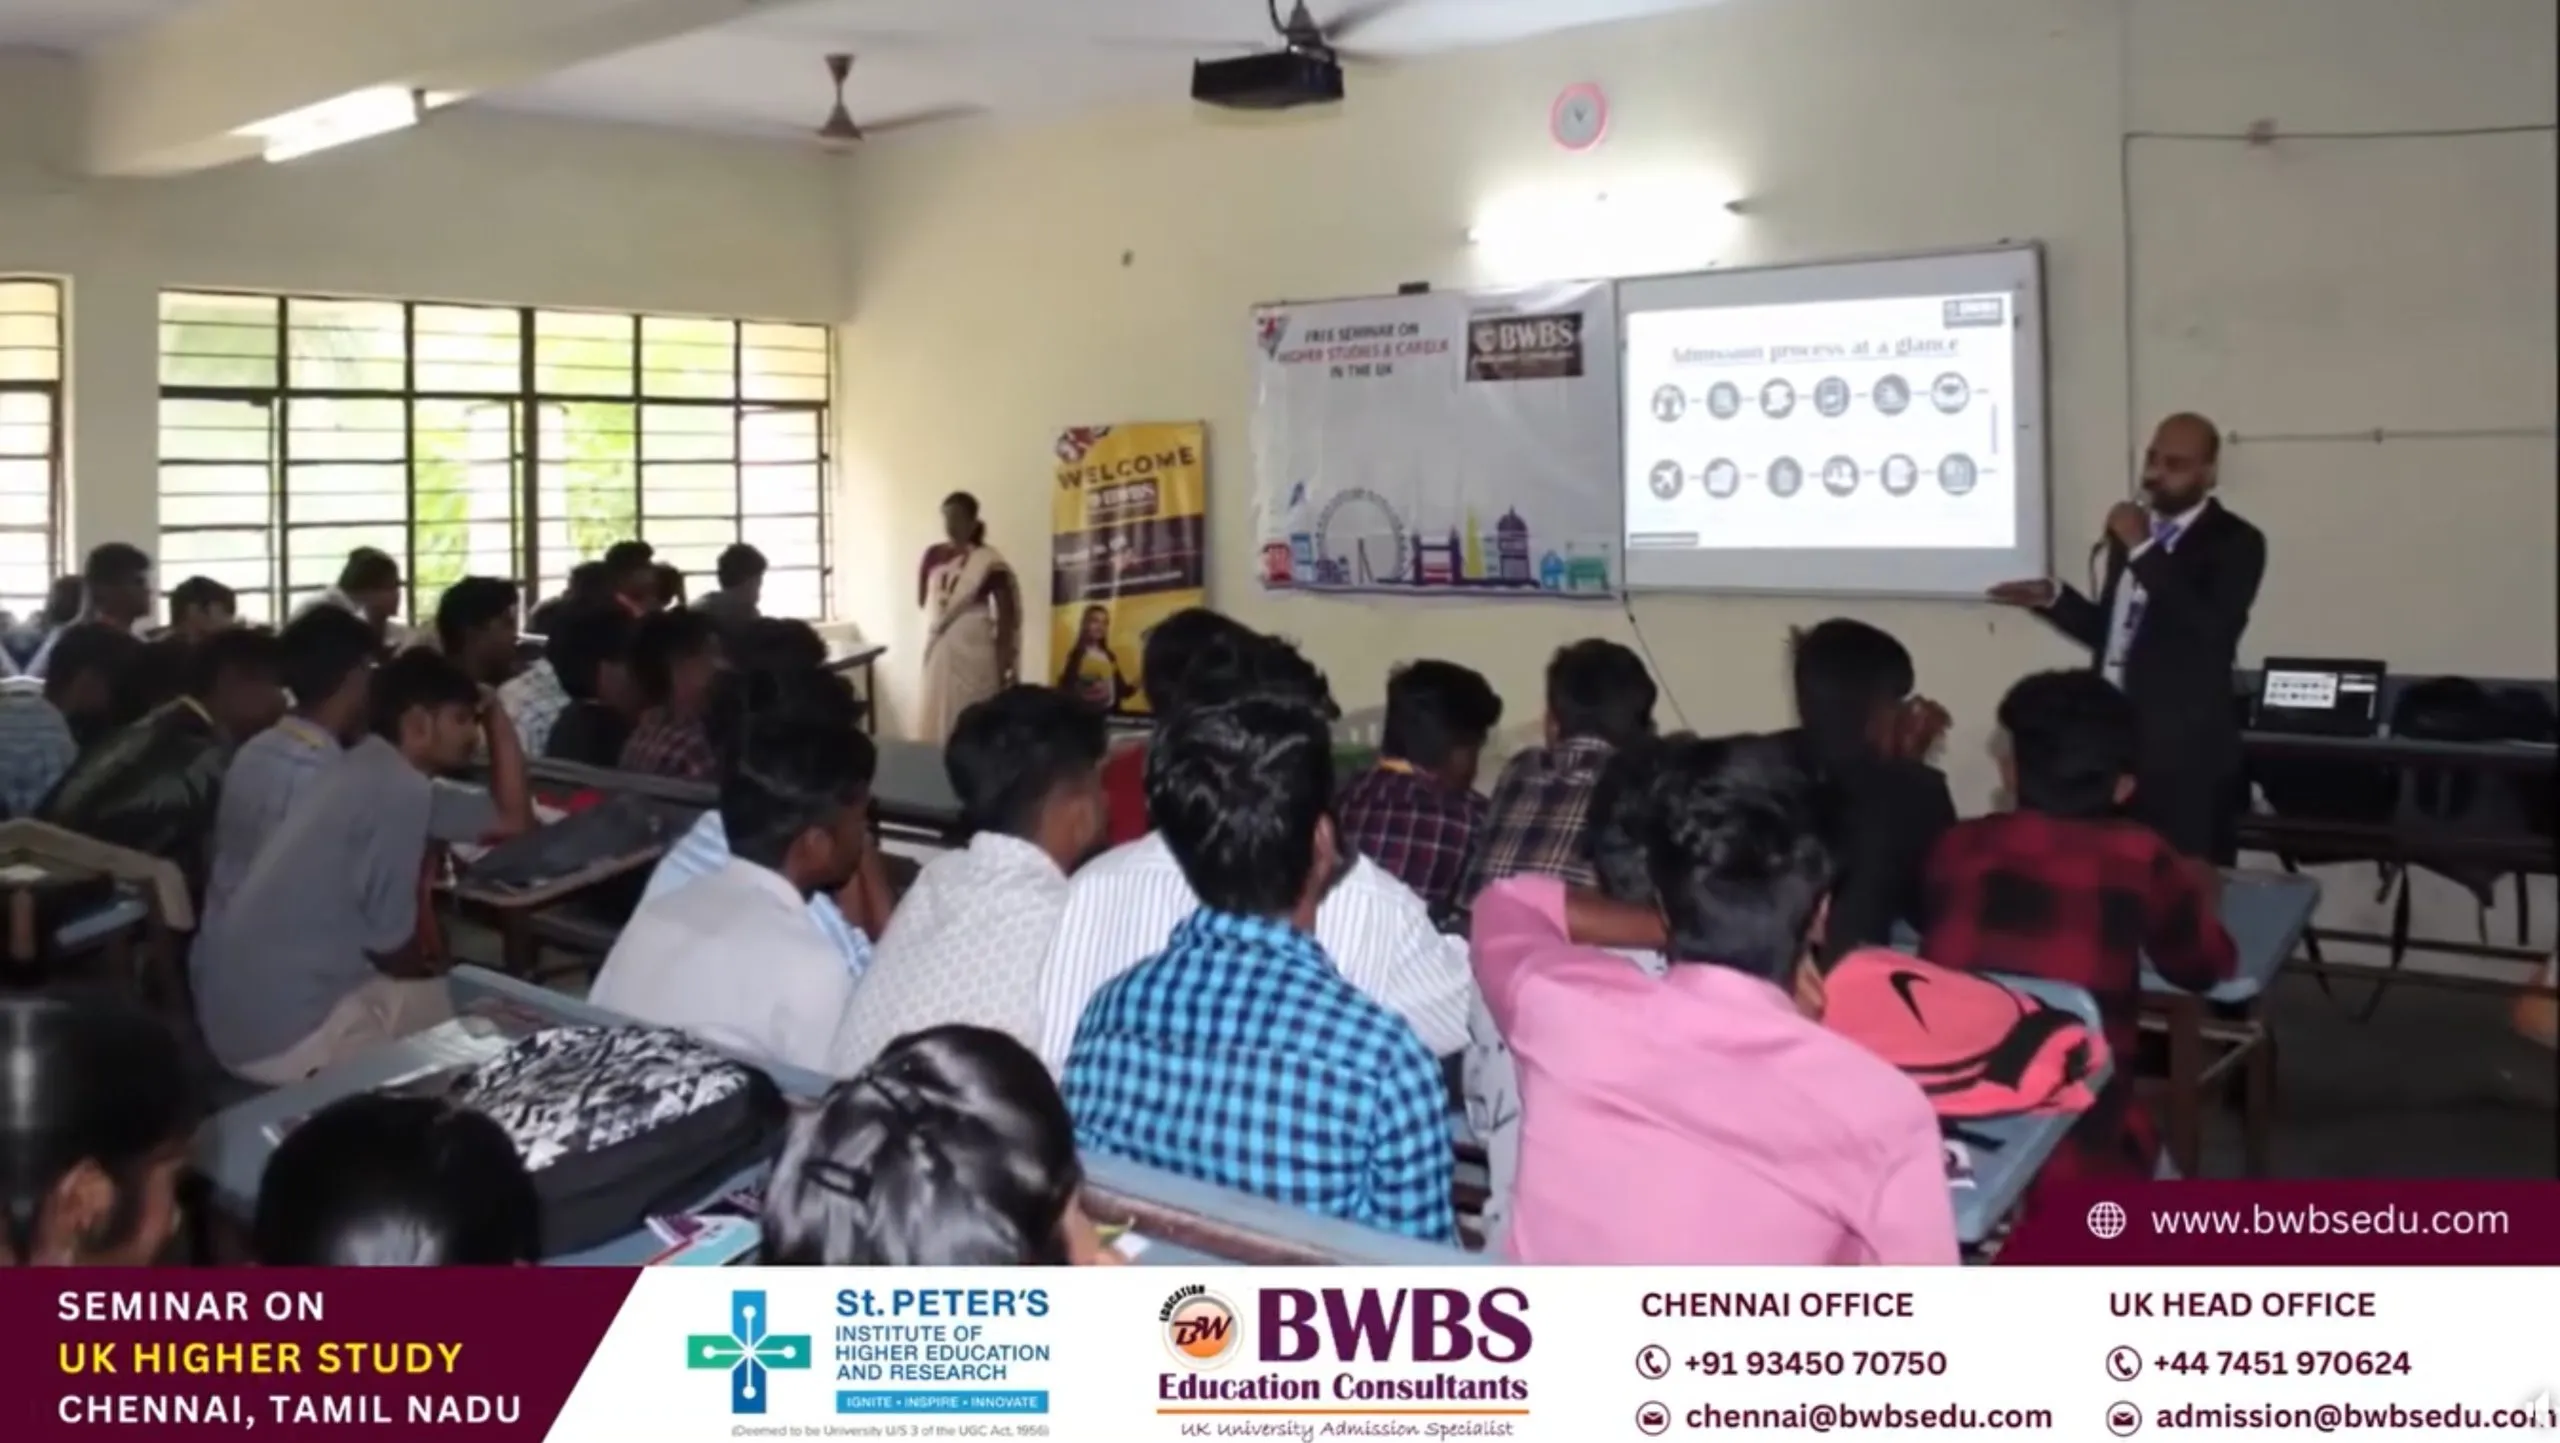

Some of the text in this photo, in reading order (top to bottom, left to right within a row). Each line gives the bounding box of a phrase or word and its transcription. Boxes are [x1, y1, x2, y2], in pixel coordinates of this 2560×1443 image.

[1338, 324, 1394, 342] SEMINAR
[1398, 323, 1420, 337] ON
[1499, 320, 1575, 351] BWBS
[1330, 362, 1394, 379] IN THE UK
[1056, 446, 1197, 490] WELCOME
